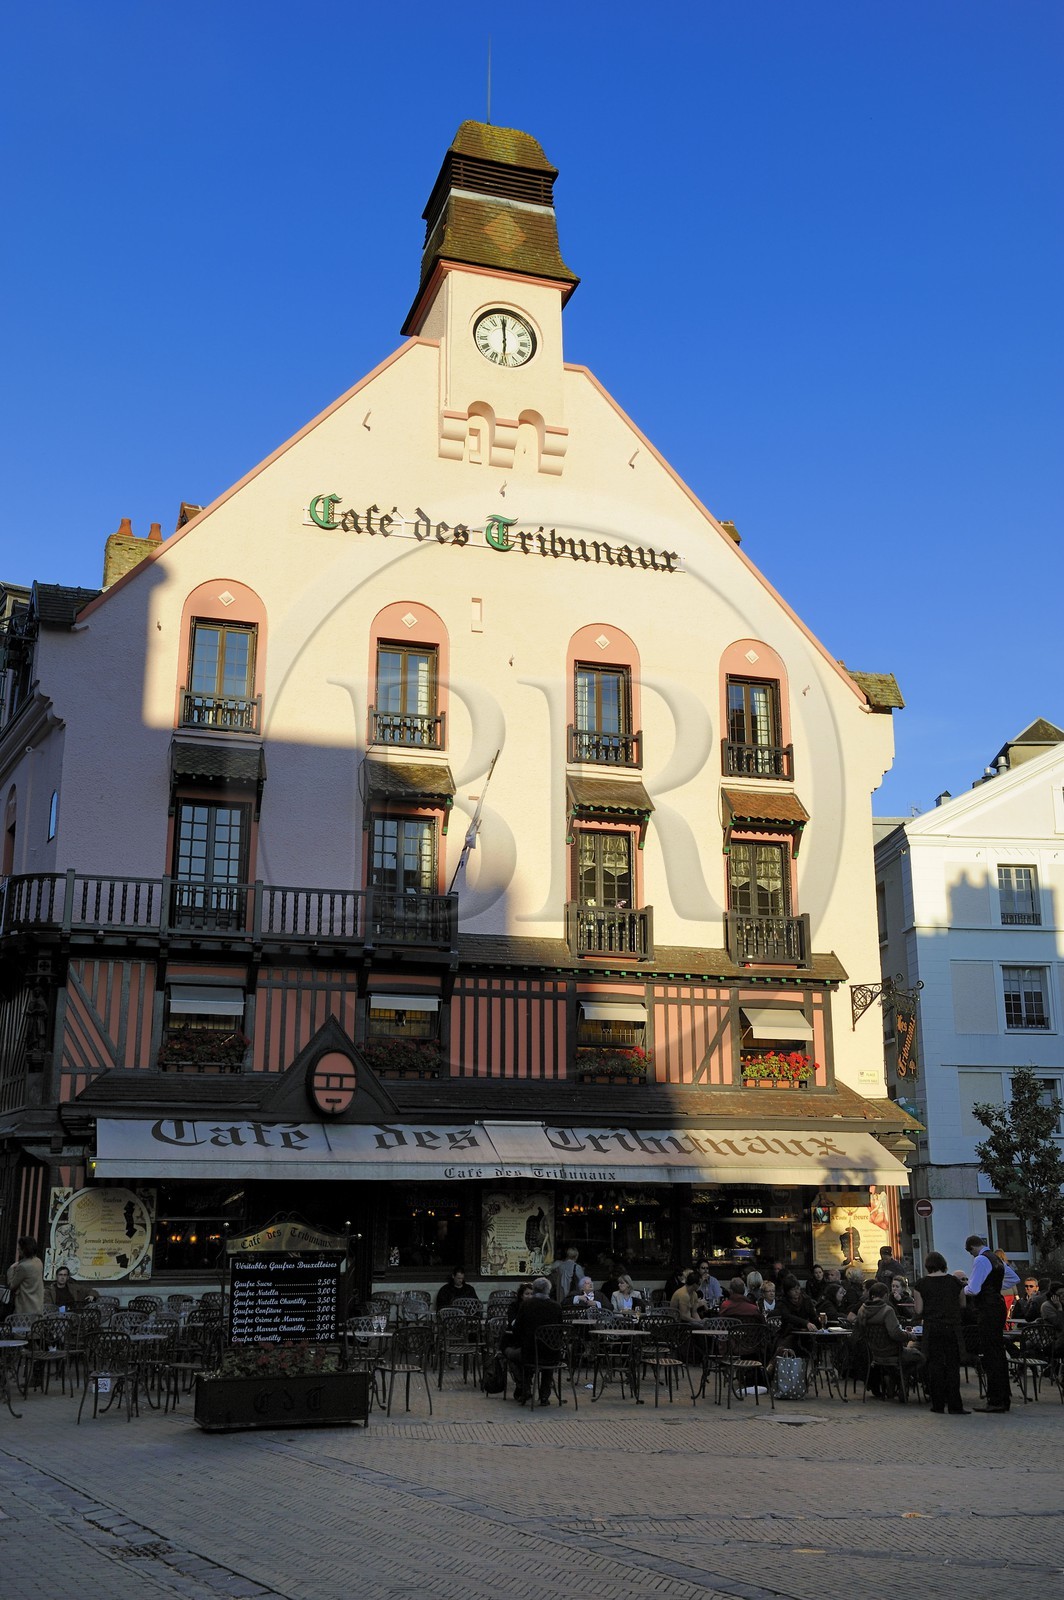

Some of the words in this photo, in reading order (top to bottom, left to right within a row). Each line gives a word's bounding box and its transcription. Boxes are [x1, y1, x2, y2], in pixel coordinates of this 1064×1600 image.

[309, 493, 397, 538] Café
[413, 506, 470, 546] des
[486, 514, 679, 574] Tribunaux
[373, 1124, 480, 1151] des
[543, 1127, 847, 1157] Tribunaux
[444, 1166, 483, 1179] Café
[494, 1168, 522, 1177] des
[533, 1168, 616, 1181] Tribunaux
[732, 1206, 764, 1214] ARTOIS
[241, 1234, 261, 1250] Café
[266, 1229, 282, 1240] des
[290, 1226, 333, 1248] Tribunaux
[234, 1261, 268, 1270] Véritables
[269, 1261, 295, 1272] Gaufres
[296, 1260, 337, 1269] Bruxelloises
[234, 1290, 255, 1298] Gaufre
[233, 1299, 254, 1307] Gaufre
[280, 1298, 306, 1306] Chantilly
[233, 1307, 254, 1316] Gaufre
[255, 1307, 282, 1315] Confiture
[232, 1317, 254, 1325] Gaufre
[232, 1326, 253, 1334] Gaufre
